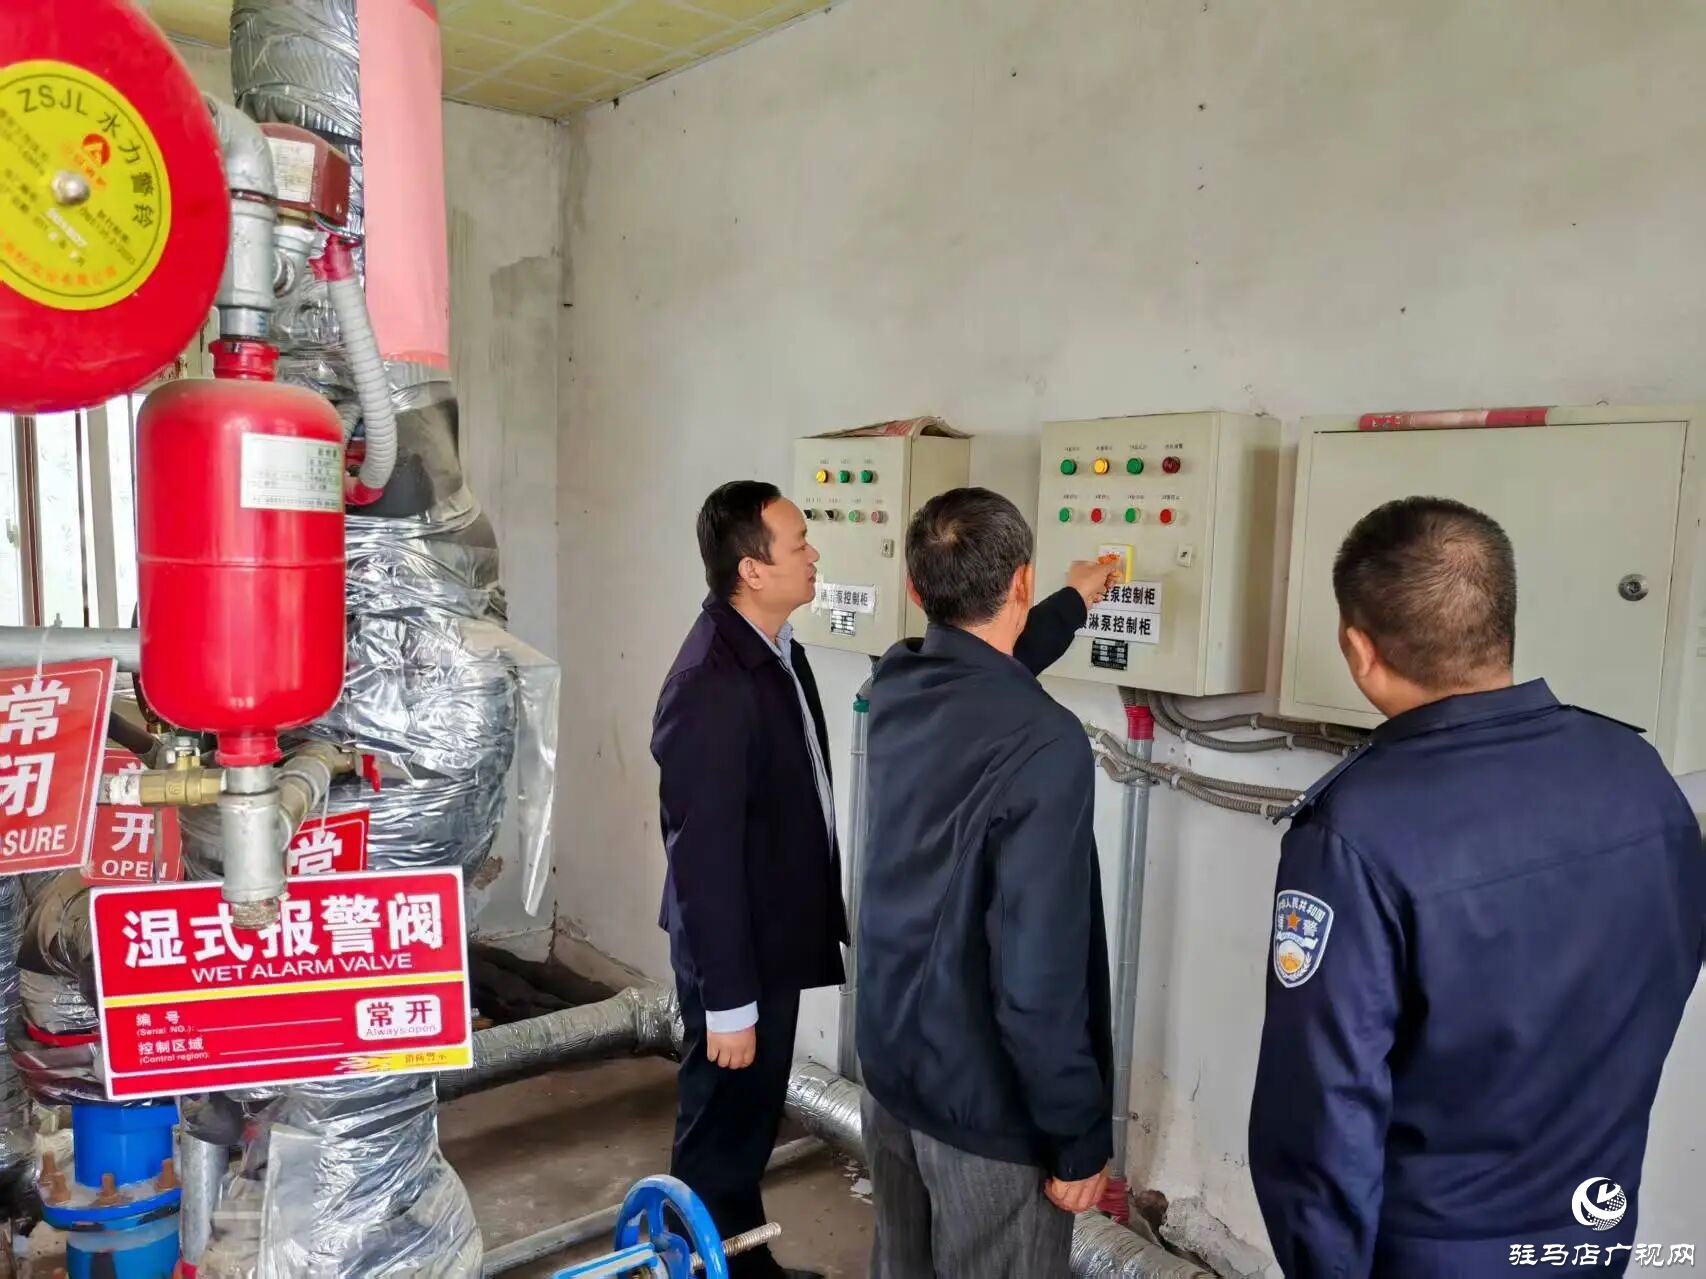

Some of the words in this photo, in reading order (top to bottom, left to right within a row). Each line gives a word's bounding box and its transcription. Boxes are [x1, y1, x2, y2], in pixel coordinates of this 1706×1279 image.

[17, 84, 88, 116] ZSJL
[1083, 613, 1151, 635] 淋泵控制柜
[122, 892, 444, 969] 湿式报警阀
[191, 963, 248, 984] WET
[251, 957, 334, 979] ALARM
[339, 952, 413, 974] VALVE
[366, 1000, 433, 1028] 常开
[138, 1037, 204, 1055] 控制区域
